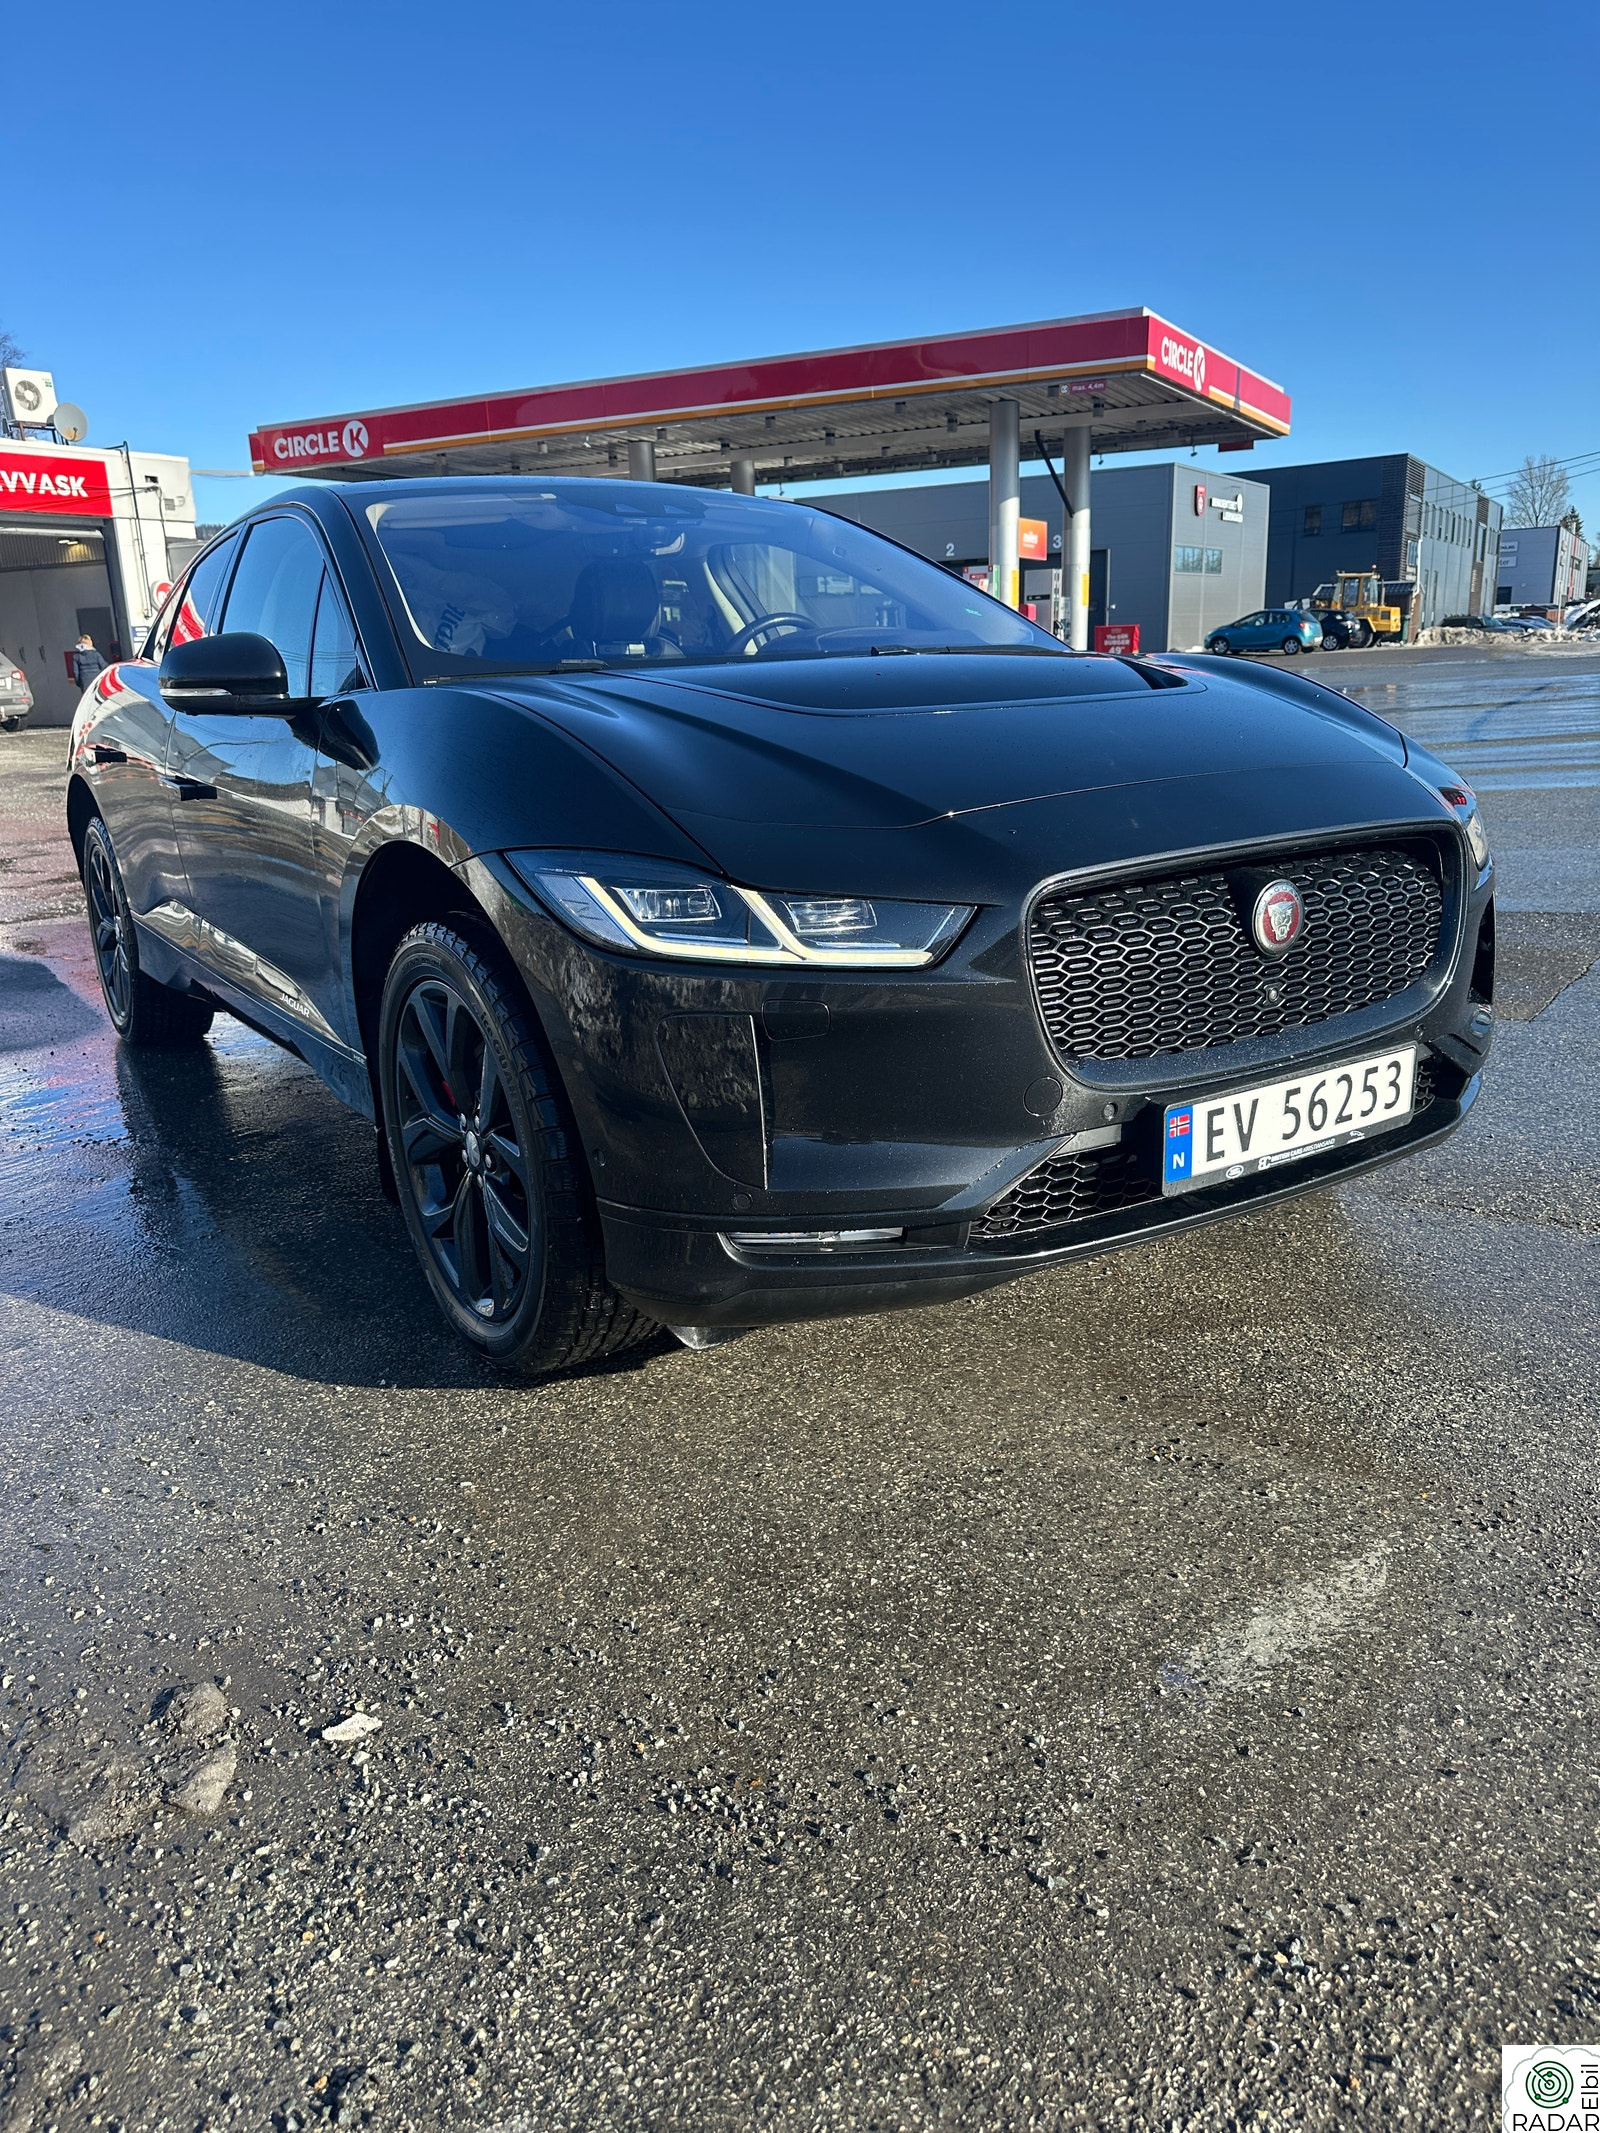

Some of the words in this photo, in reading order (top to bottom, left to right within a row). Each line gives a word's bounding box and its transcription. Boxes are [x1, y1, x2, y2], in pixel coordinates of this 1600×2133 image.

[1161, 336, 1194, 377] CIRCLE
[274, 431, 340, 459] CIRCLE
[346, 423, 369, 455] K
[0, 470, 88, 497] VVASK
[946, 543, 955, 556] 2
[1053, 535, 1062, 549] 3
[280, 993, 310, 1018] JAGUAR
[1206, 1098, 1259, 1162] EV
[1281, 1060, 1401, 1141] 56253
[1172, 1151, 1185, 1170] N
[1290, 1147, 1304, 1157] CARS
